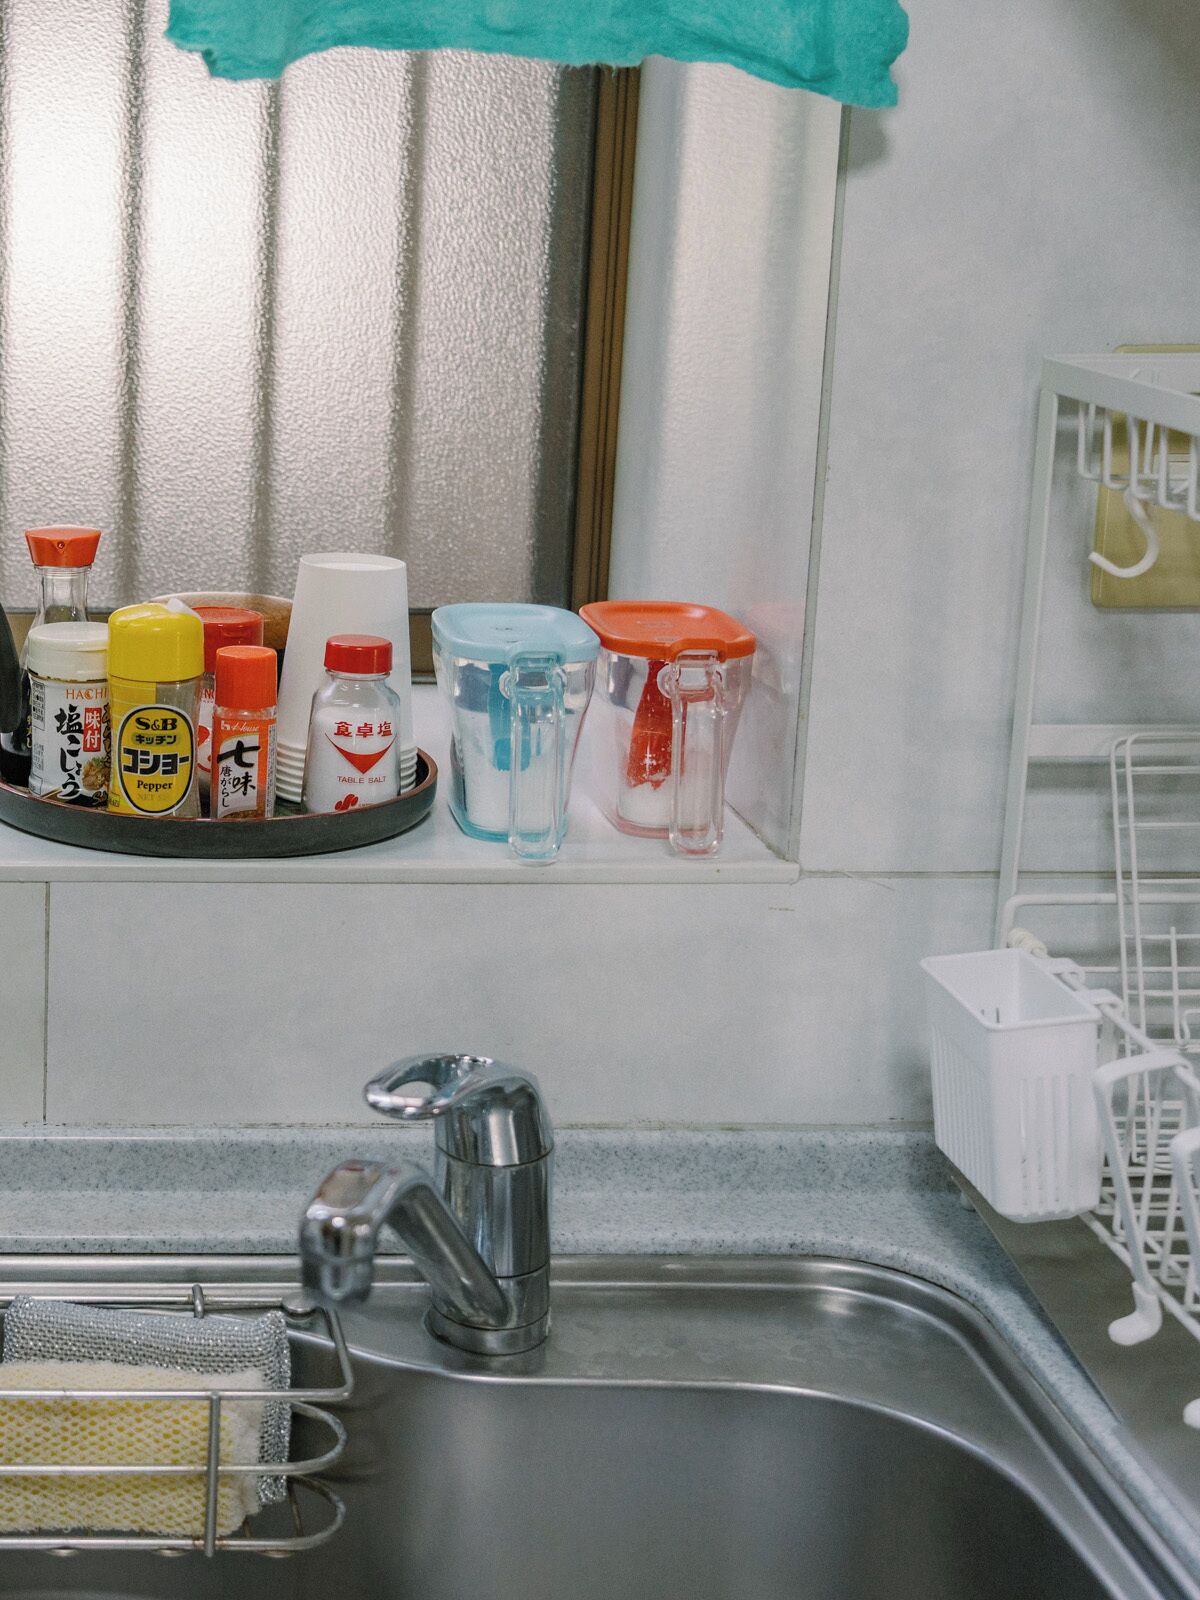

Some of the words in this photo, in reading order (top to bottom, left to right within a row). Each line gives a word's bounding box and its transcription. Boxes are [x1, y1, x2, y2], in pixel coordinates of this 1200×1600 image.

[85, 710, 100, 749] 味付
[135, 717, 178, 731] S&B
[333, 721, 393, 738] 食卓塩
[54, 703, 84, 798] 塩こしょう
[135, 734, 177, 745] キッチン
[122, 746, 190, 776] コショー
[216, 740, 261, 797] 七味
[137, 780, 173, 792] Pepper
[220, 766, 233, 808] 唐がらし
[337, 775, 364, 784] TABLE
[368, 775, 386, 783] SALT
